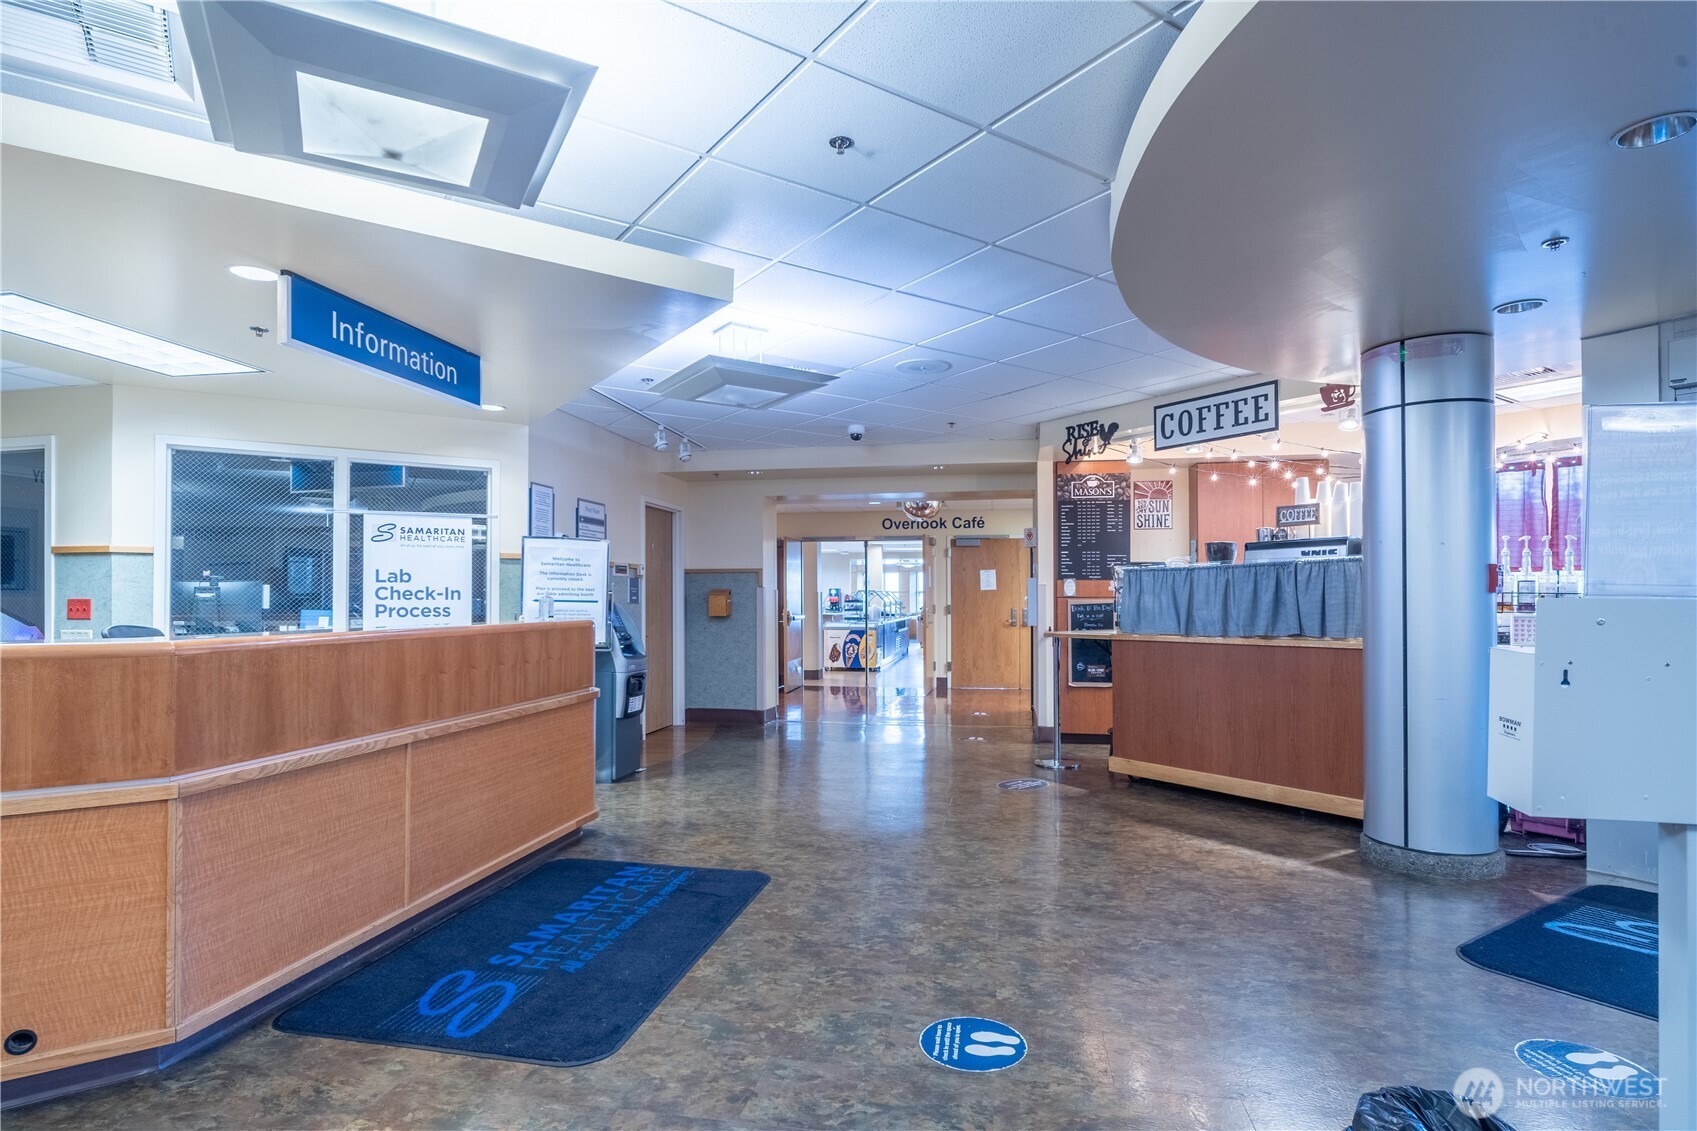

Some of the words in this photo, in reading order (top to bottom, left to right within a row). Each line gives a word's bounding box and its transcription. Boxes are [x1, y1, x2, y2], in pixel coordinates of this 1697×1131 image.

[331, 310, 458, 385] Information
[1161, 393, 1269, 440] COFFEE
[1066, 420, 1099, 441] RISE
[1074, 488, 1112, 496] MASON'S
[1148, 500, 1170, 513] SUN
[1136, 514, 1170, 528] SHINE
[1280, 508, 1316, 522] COFFEE
[882, 518, 948, 530] Overlook
[952, 516, 985, 528] Café
[400, 527, 465, 535] SAMARITAN
[376, 569, 412, 583] Lab
[375, 586, 461, 600] Check-In
[376, 604, 451, 618] Process
[1499, 716, 1522, 727] BOWMAN
[488, 866, 648, 967] SAMARITAN
[521, 868, 674, 970] HEALTHCARE
